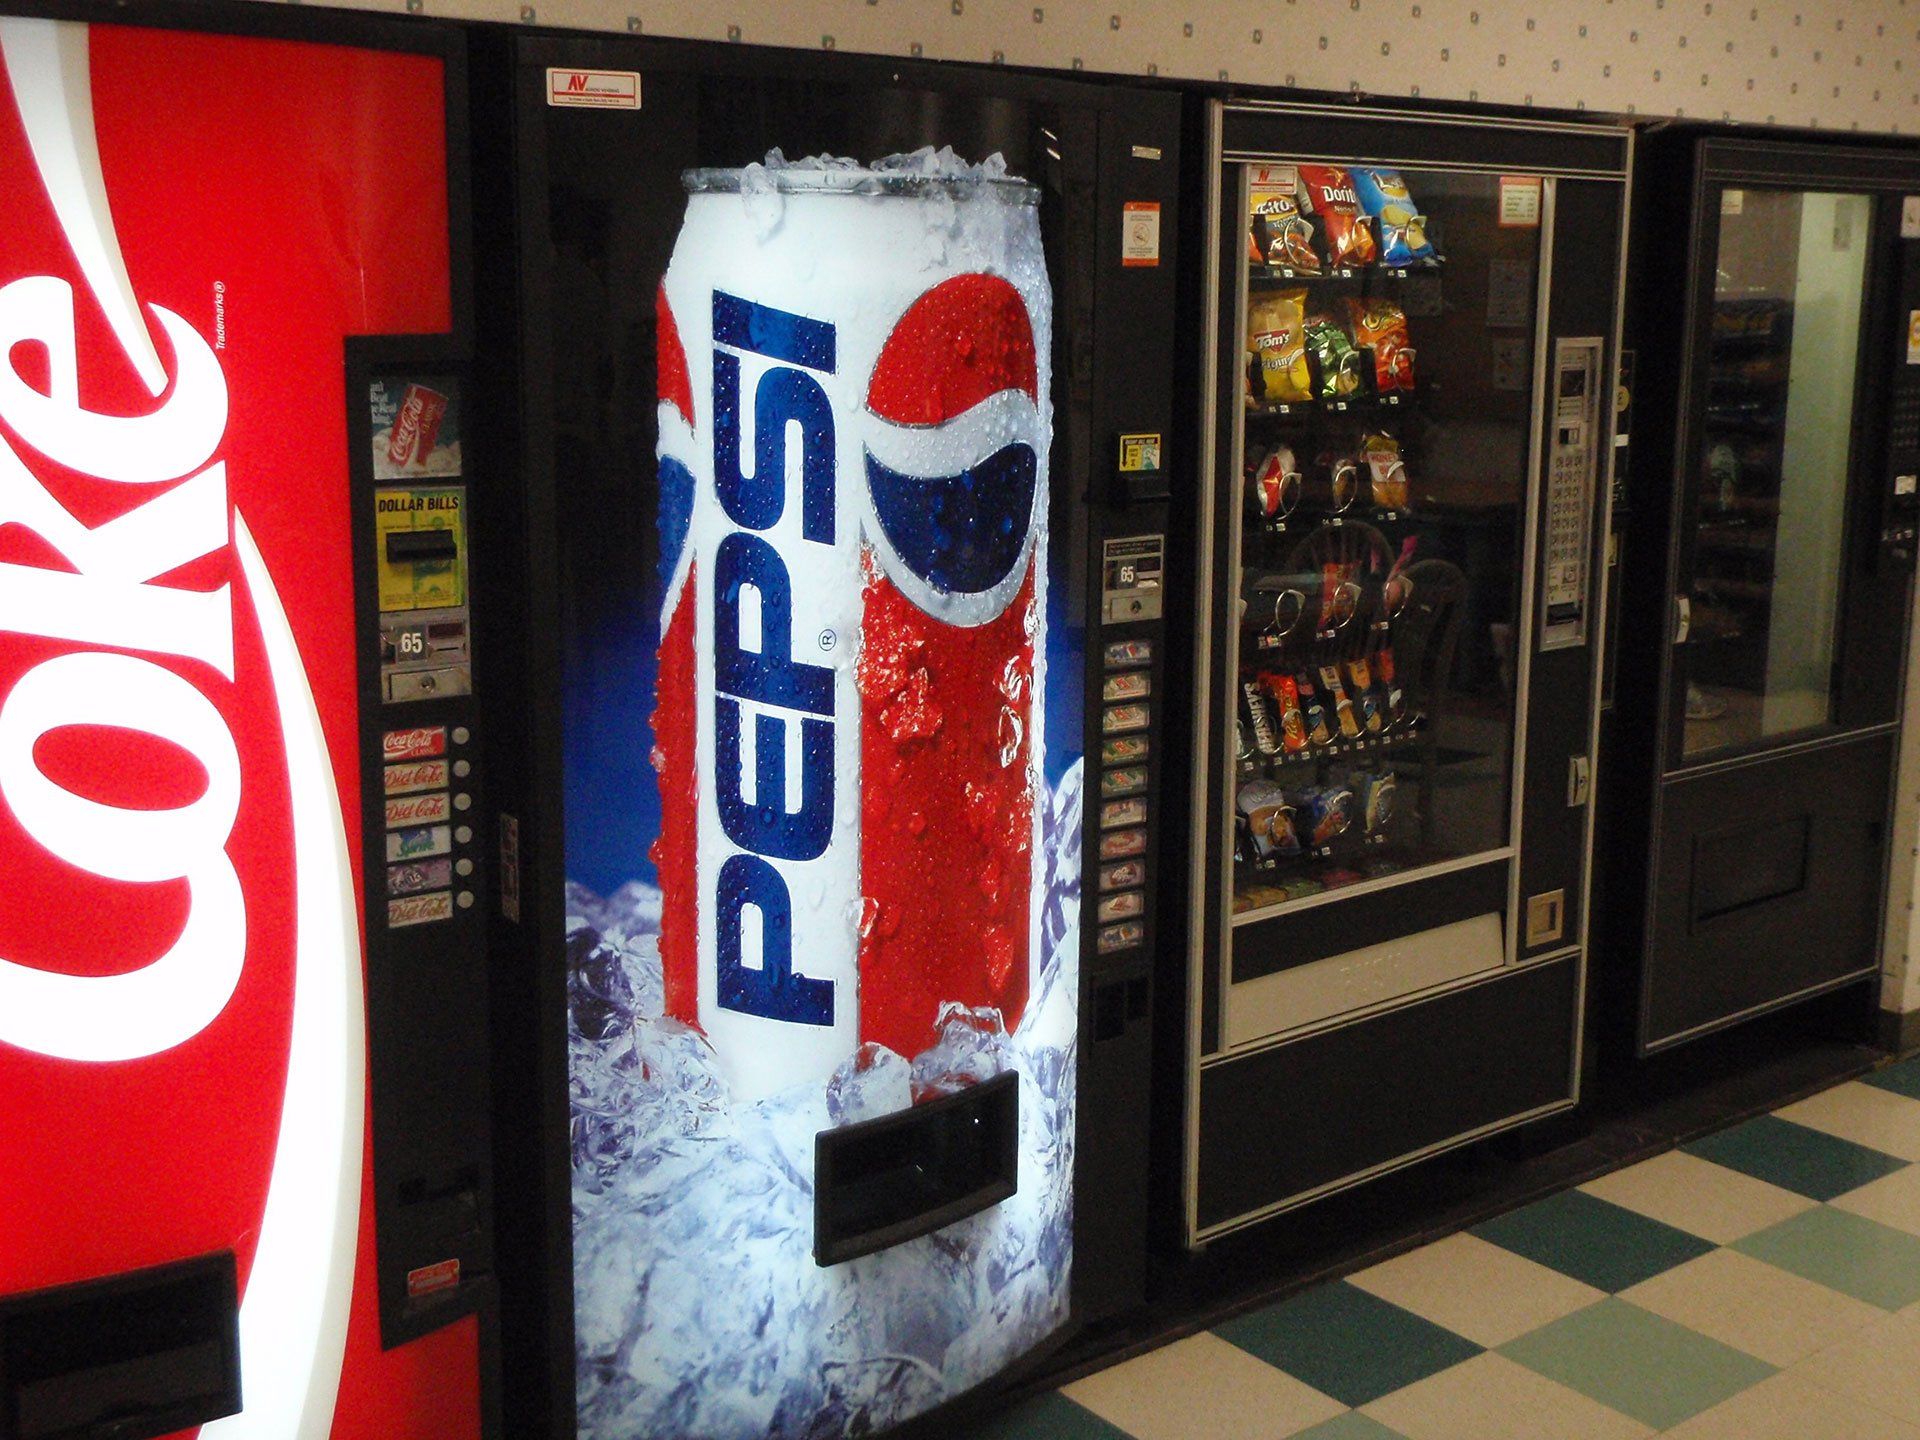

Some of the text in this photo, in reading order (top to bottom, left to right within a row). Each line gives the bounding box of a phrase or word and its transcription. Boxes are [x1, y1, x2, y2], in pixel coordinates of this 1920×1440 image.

[1255, 333, 1290, 350] Tom's
[379, 496, 459, 512] DOLLAR BILLS
[1120, 566, 1134, 583] 65
[401, 632, 423, 653] 65
[713, 289, 836, 1027] PEPSI
